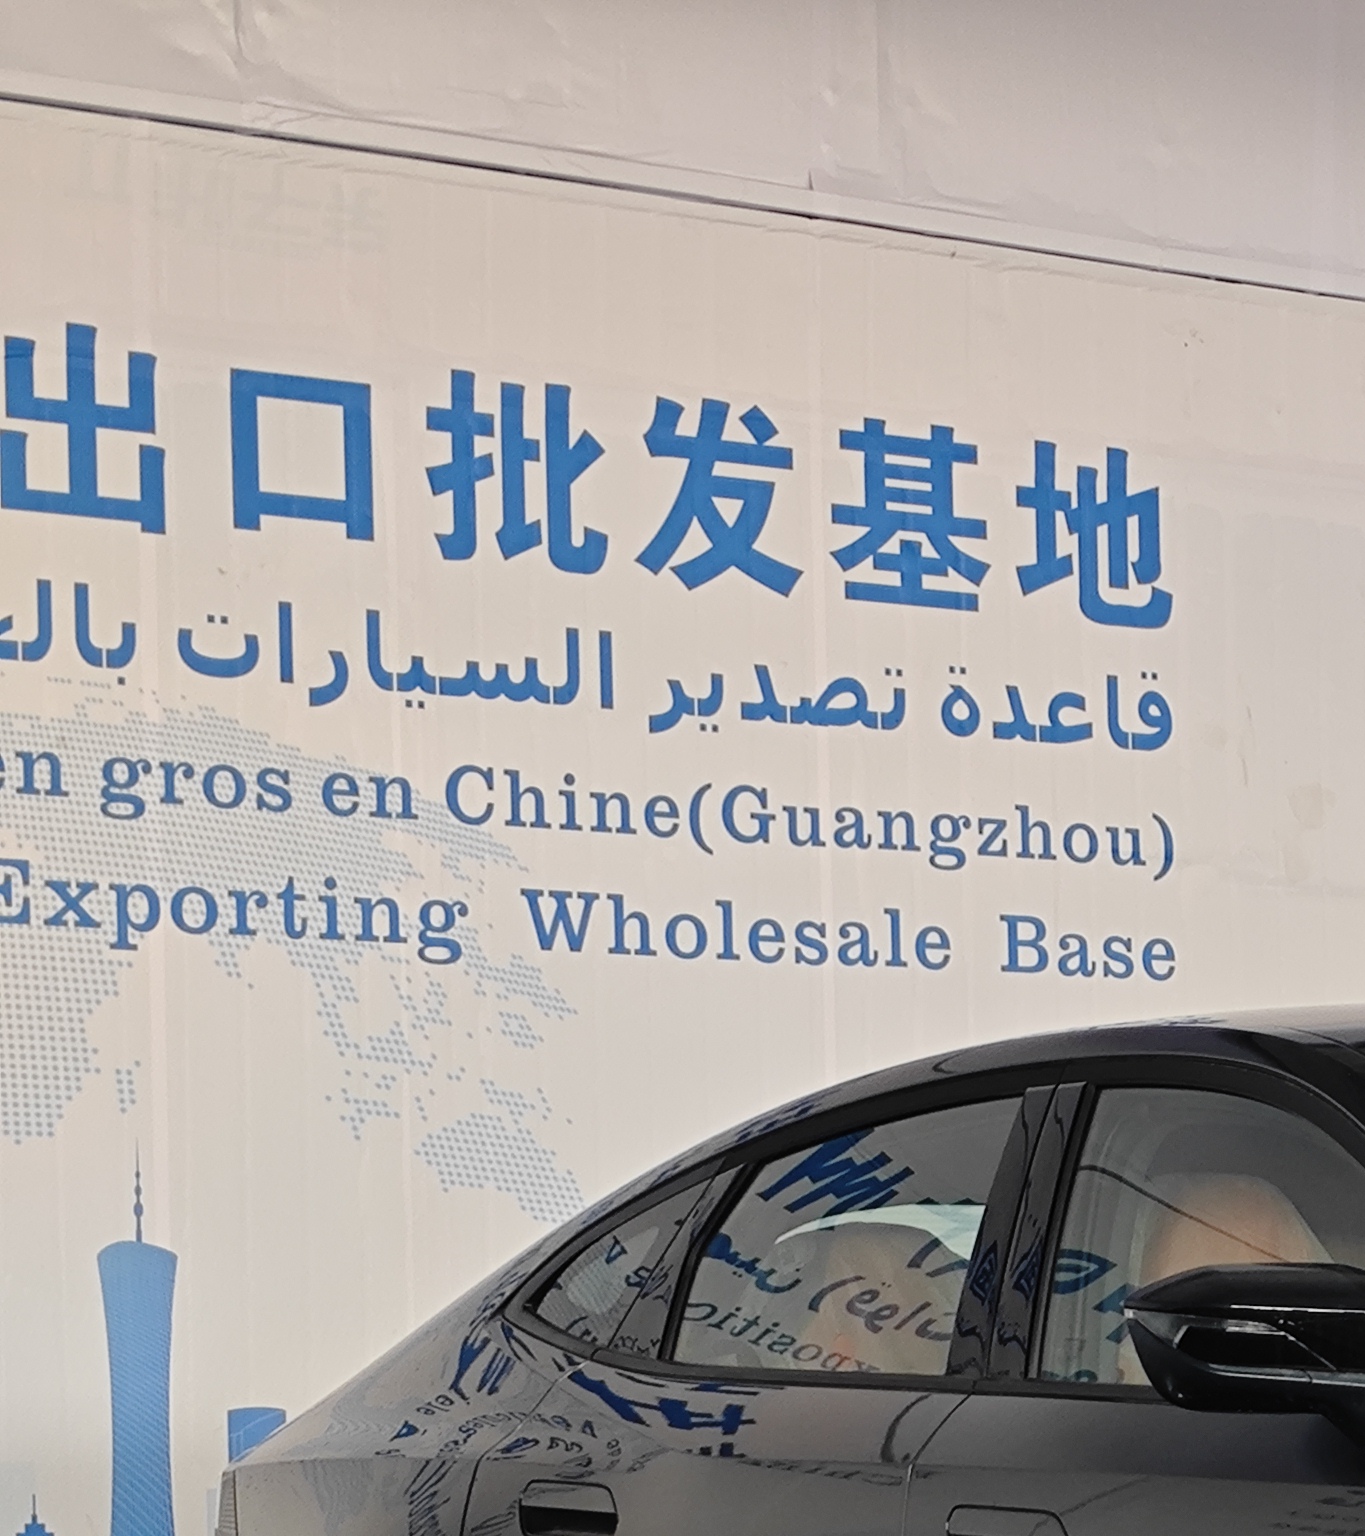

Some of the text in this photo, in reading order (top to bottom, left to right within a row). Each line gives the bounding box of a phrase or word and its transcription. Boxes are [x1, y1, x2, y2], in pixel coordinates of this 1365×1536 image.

[0, 322, 1174, 629] 出口批发基地
[179, 603, 614, 710] السيارات
[650, 666, 906, 734] تصدير
[942, 676, 1173, 752] قاعدة
[0, 753, 1174, 881] n gros en Chine(Guangzhou)
[522, 890, 951, 971] Wholesale
[1001, 916, 1175, 981] Base
